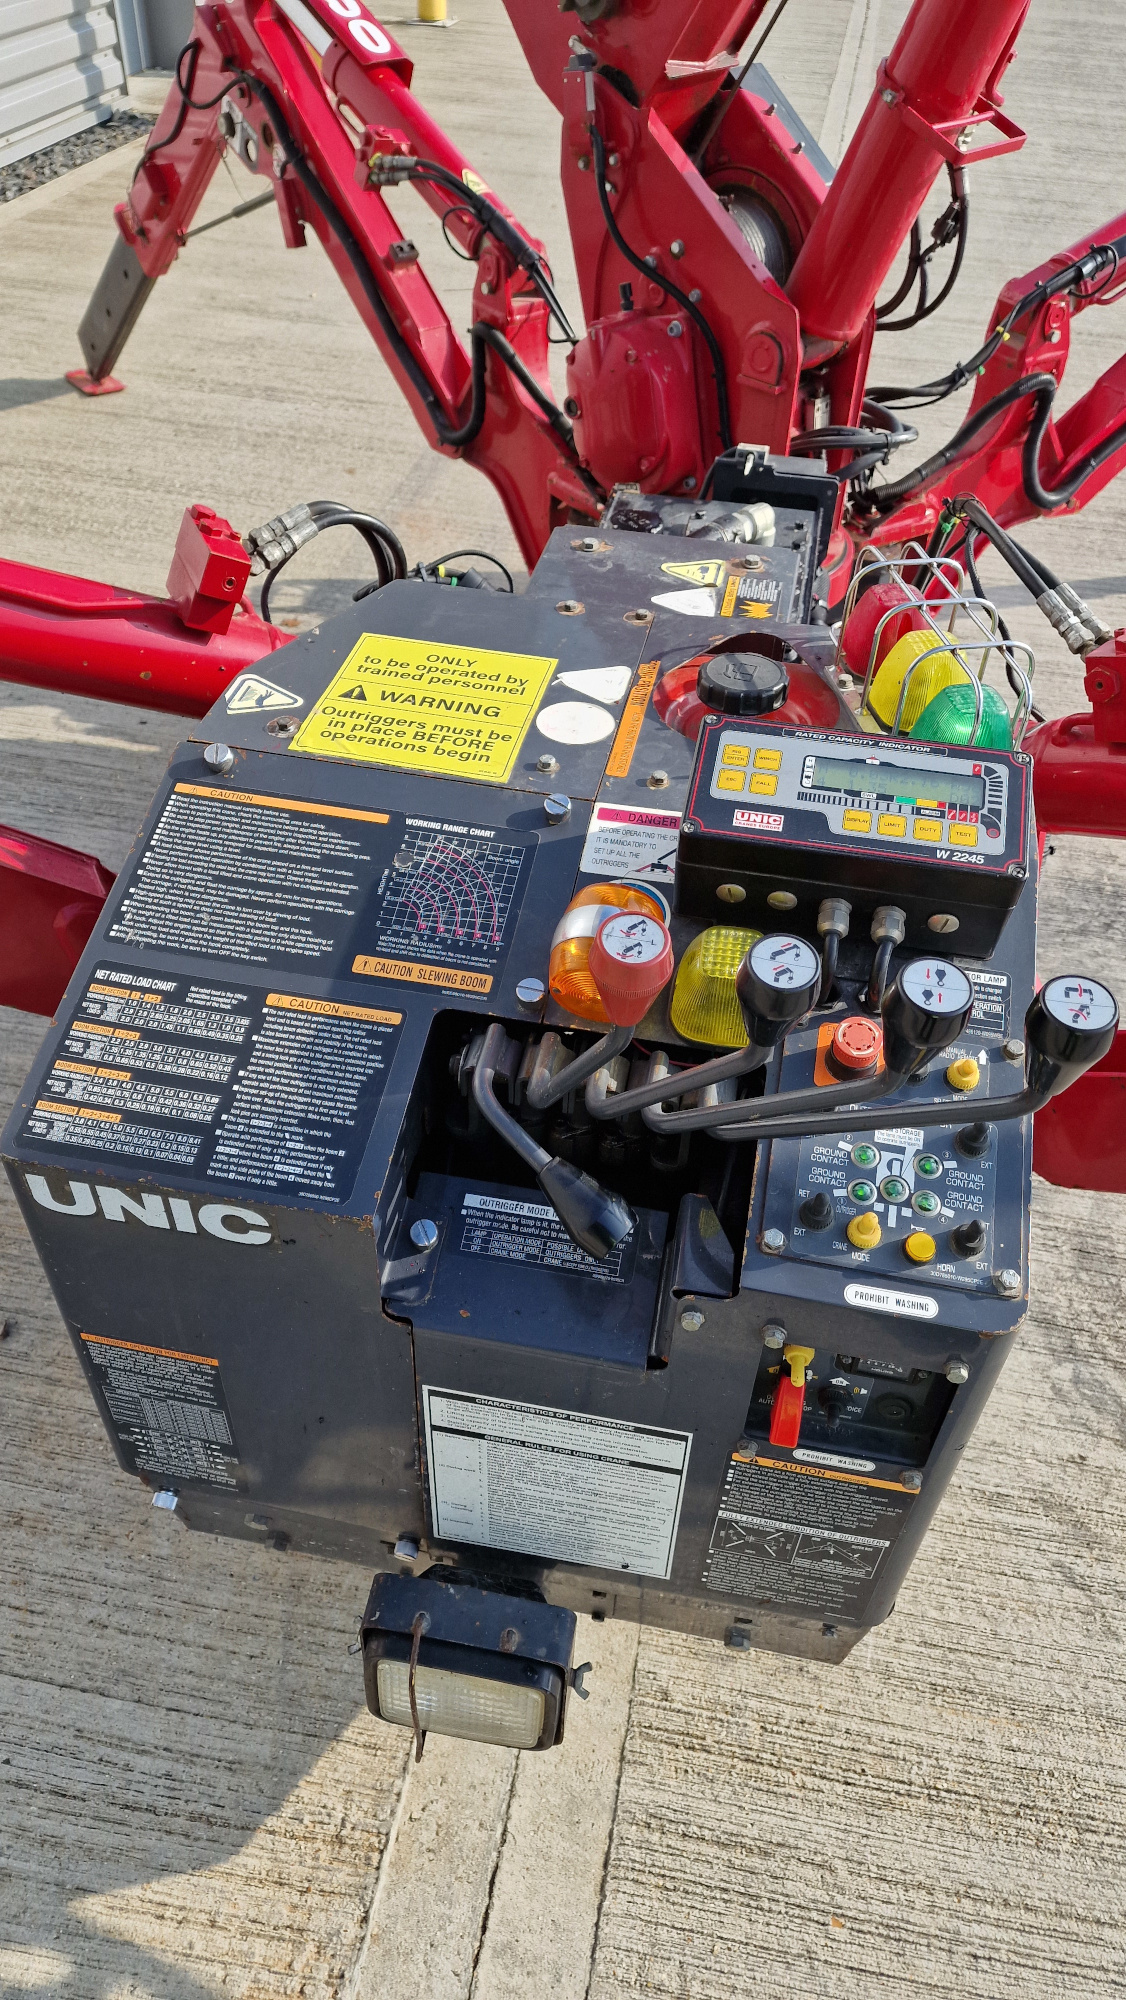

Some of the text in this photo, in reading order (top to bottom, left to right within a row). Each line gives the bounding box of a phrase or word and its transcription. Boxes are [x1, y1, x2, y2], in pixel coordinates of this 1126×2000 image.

[427, 655, 477, 668] ONLY
[365, 655, 529, 687] to be operated by
[357, 665, 526, 696] trained personnel
[380, 690, 501, 717] WARNING
[322, 706, 513, 742] Outriggers must be
[327, 718, 495, 751] in place BEFORE
[320, 730, 490, 762] operations begin
[795, 732, 930, 753] RATED CAPACITY INDICATOR
[210, 790, 254, 802] CAUTION
[628, 813, 677, 827] DANGER
[736, 811, 781, 825] UNIC
[406, 818, 495, 837] WORKING RANGE CHART
[622, 830, 655, 839] OPERATING
[610, 839, 647, 848] MANDATORY
[592, 858, 629, 868] OUTRIGGERS
[936, 850, 984, 864] W 2245
[380, 935, 409, 944] WORKING
[95, 969, 176, 992] NET RATED LOAD CHART
[374, 962, 487, 989] CAUTION SLEWING BOOM
[984, 976, 1004, 984] LAMP
[106, 987, 128, 996] SECTION
[290, 999, 339, 1014] CAUTION
[91, 1025, 111, 1033] SECTION
[945, 1046, 966, 1054] MANUAL
[74, 1064, 94, 1073] SECTION
[55, 1104, 75, 1113] SECTION
[814, 1146, 848, 1158] GROUND
[811, 1154, 849, 1166] CONTACT
[812, 1167, 846, 1179] GROUND
[948, 1170, 984, 1182] GROUND
[809, 1175, 847, 1187] CONTACT
[946, 1178, 985, 1190] CONTACT
[799, 1190, 810, 1198] RET
[947, 1192, 983, 1203] GROUND
[25, 1174, 271, 1245] UNIC
[479, 1198, 550, 1216] OUTRIGGER MODE
[945, 1200, 984, 1212] CONTACT
[466, 1218, 491, 1228] outrigger
[520, 1226, 538, 1235] careful
[468, 1209, 484, 1217] When
[495, 1213, 519, 1223] indicator
[521, 1218, 535, 1226] lamp
[550, 1222, 560, 1230] the
[794, 1228, 806, 1236] EXT
[494, 1232, 525, 1242] OPERATION
[526, 1238, 542, 1246] MODE
[547, 1242, 574, 1251] POSSIBLE
[833, 1241, 847, 1250] CRANE
[490, 1248, 509, 1257] CRANE
[510, 1251, 526, 1259] MODE
[544, 1257, 562, 1265] CRANE
[492, 1240, 523, 1251] OUTRIGGER
[545, 1250, 581, 1260] OUTRIGGERS
[852, 1252, 870, 1262] MODE
[937, 1264, 955, 1273] HORN
[976, 1262, 988, 1270] EXT
[855, 1291, 929, 1311] PROHIBIT WASHING
[476, 1398, 553, 1417] CHARACTERISTICS
[569, 1415, 635, 1431] PERFORMANCE
[485, 1435, 523, 1447] GENERAL
[525, 1442, 553, 1452] RULES
[573, 1451, 599, 1460] USING
[601, 1456, 630, 1465] CRANE
[802, 1452, 867, 1469] PROHIBIT WASHING
[772, 1462, 870, 1484] CAUTION OUTRIGGERS
[722, 1512, 743, 1521] FULLY
[745, 1516, 783, 1528] EXTENDED
[785, 1522, 824, 1535] CONDITION
[839, 1533, 886, 1546] OUTRIGGERS
